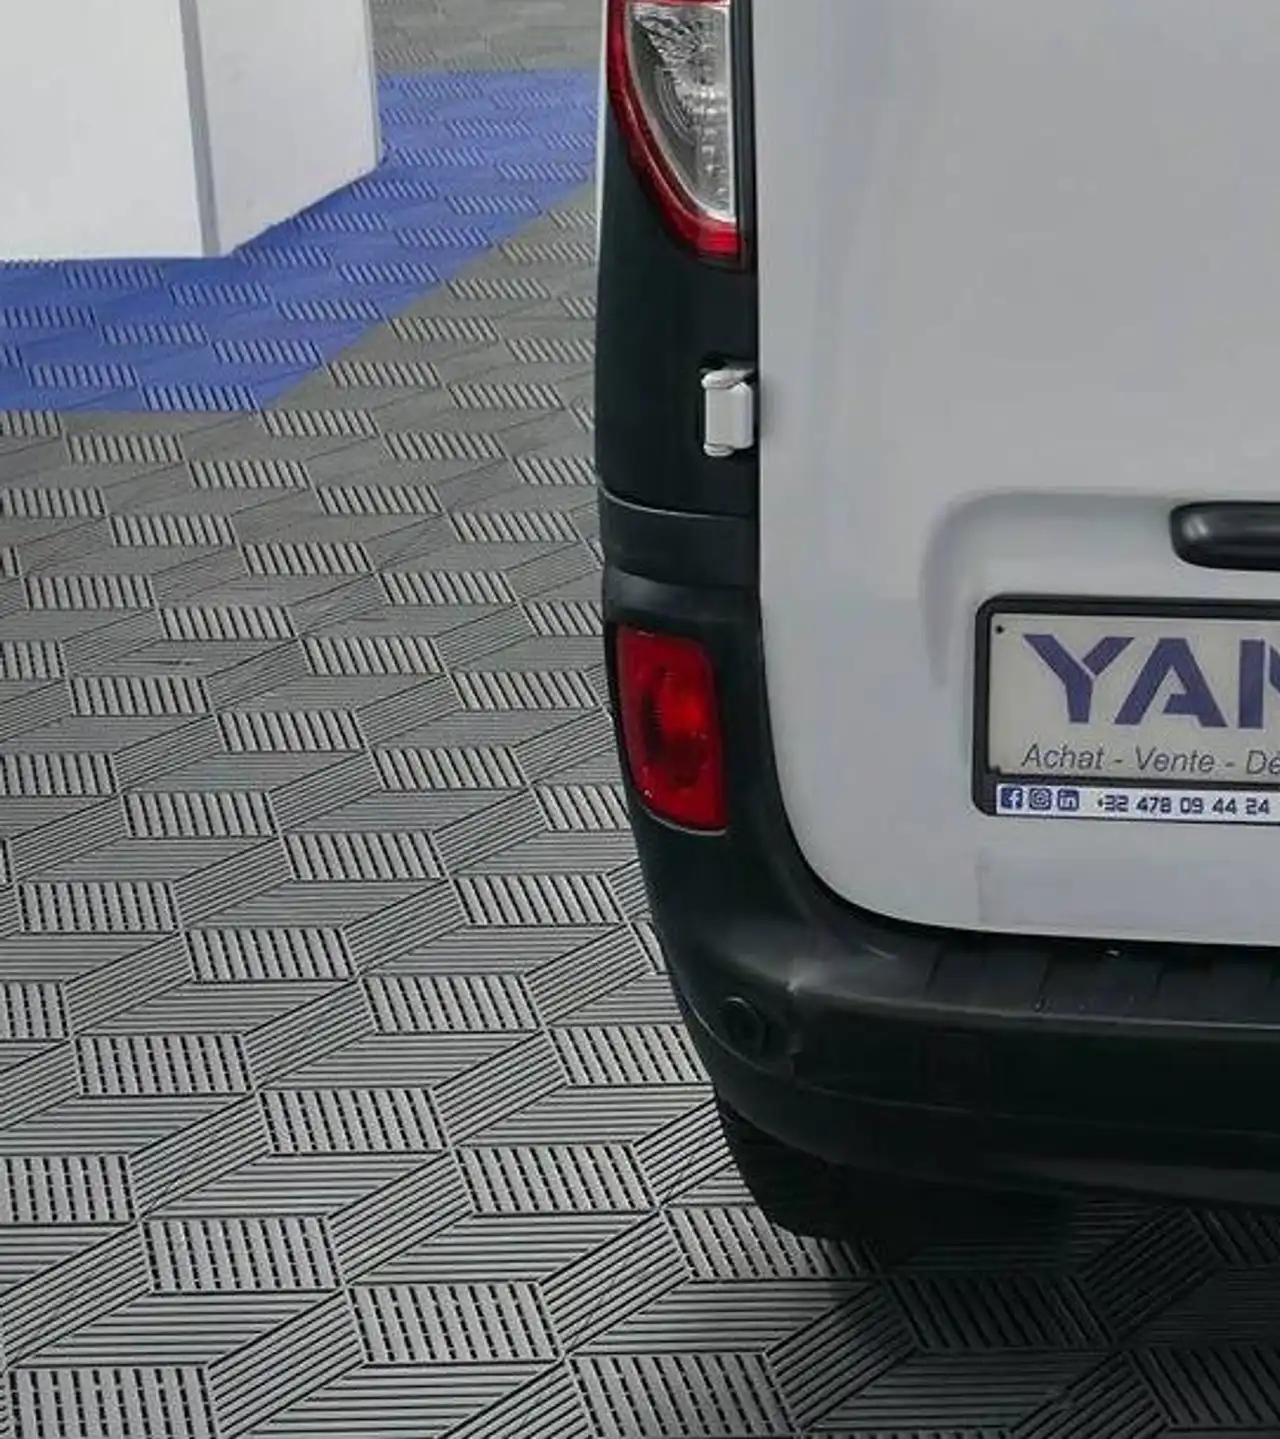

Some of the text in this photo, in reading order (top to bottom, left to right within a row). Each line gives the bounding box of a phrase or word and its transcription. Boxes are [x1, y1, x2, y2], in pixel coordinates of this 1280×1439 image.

[1020, 743, 1105, 771] Achat
[1134, 746, 1215, 774] Vente
[1136, 796, 1172, 813] 478
[1179, 797, 1204, 813] 09
[1211, 798, 1237, 814] 44
[1245, 798, 1271, 815] 24
